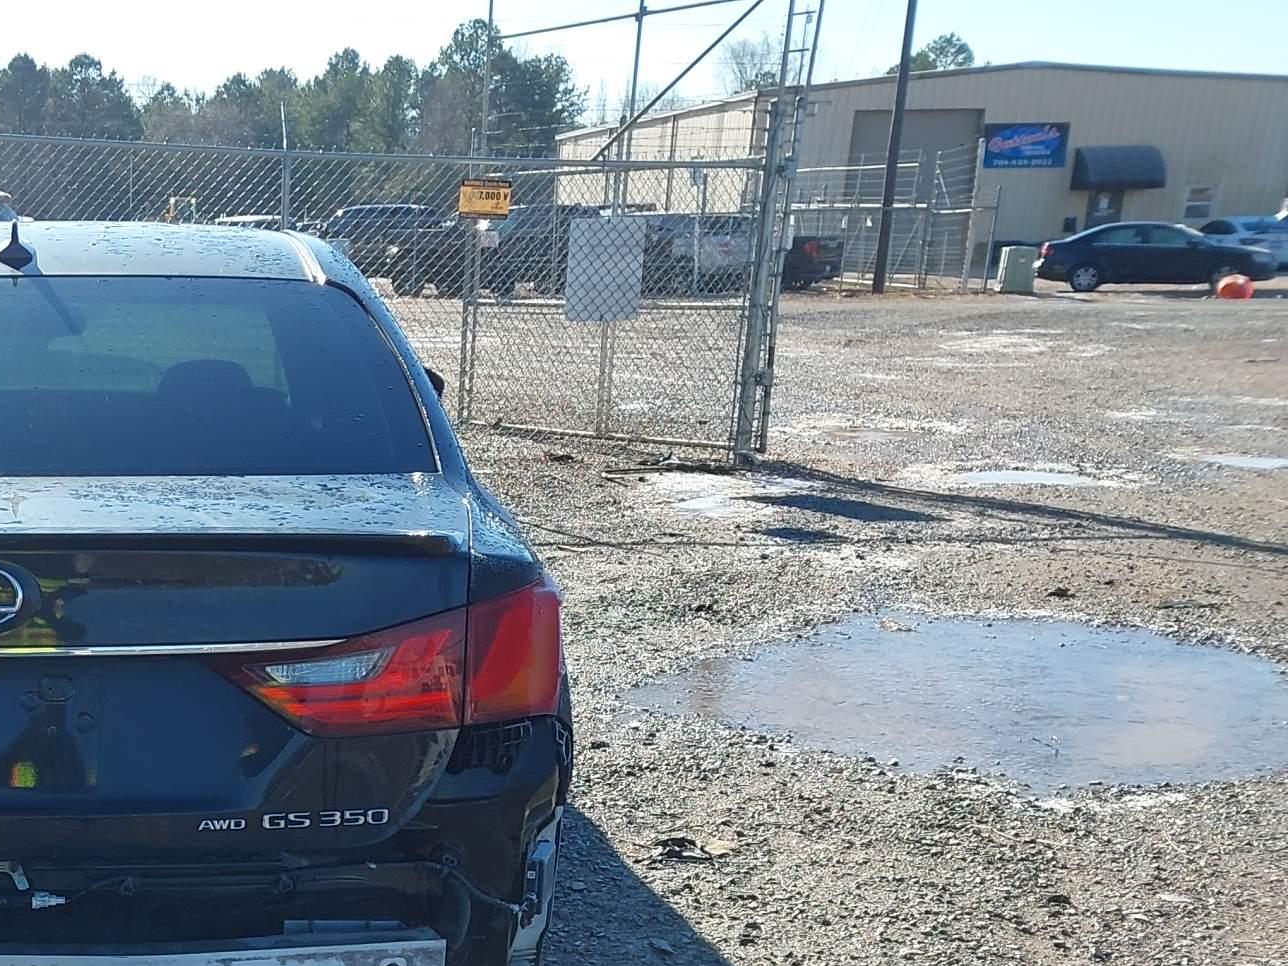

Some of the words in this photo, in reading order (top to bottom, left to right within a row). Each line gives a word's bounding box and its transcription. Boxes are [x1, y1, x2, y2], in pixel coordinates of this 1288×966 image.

[479, 191, 501, 201] 7,000
[503, 191, 509, 201] V
[198, 819, 246, 831] AWD
[262, 812, 311, 829] GS
[319, 809, 389, 827] 350
